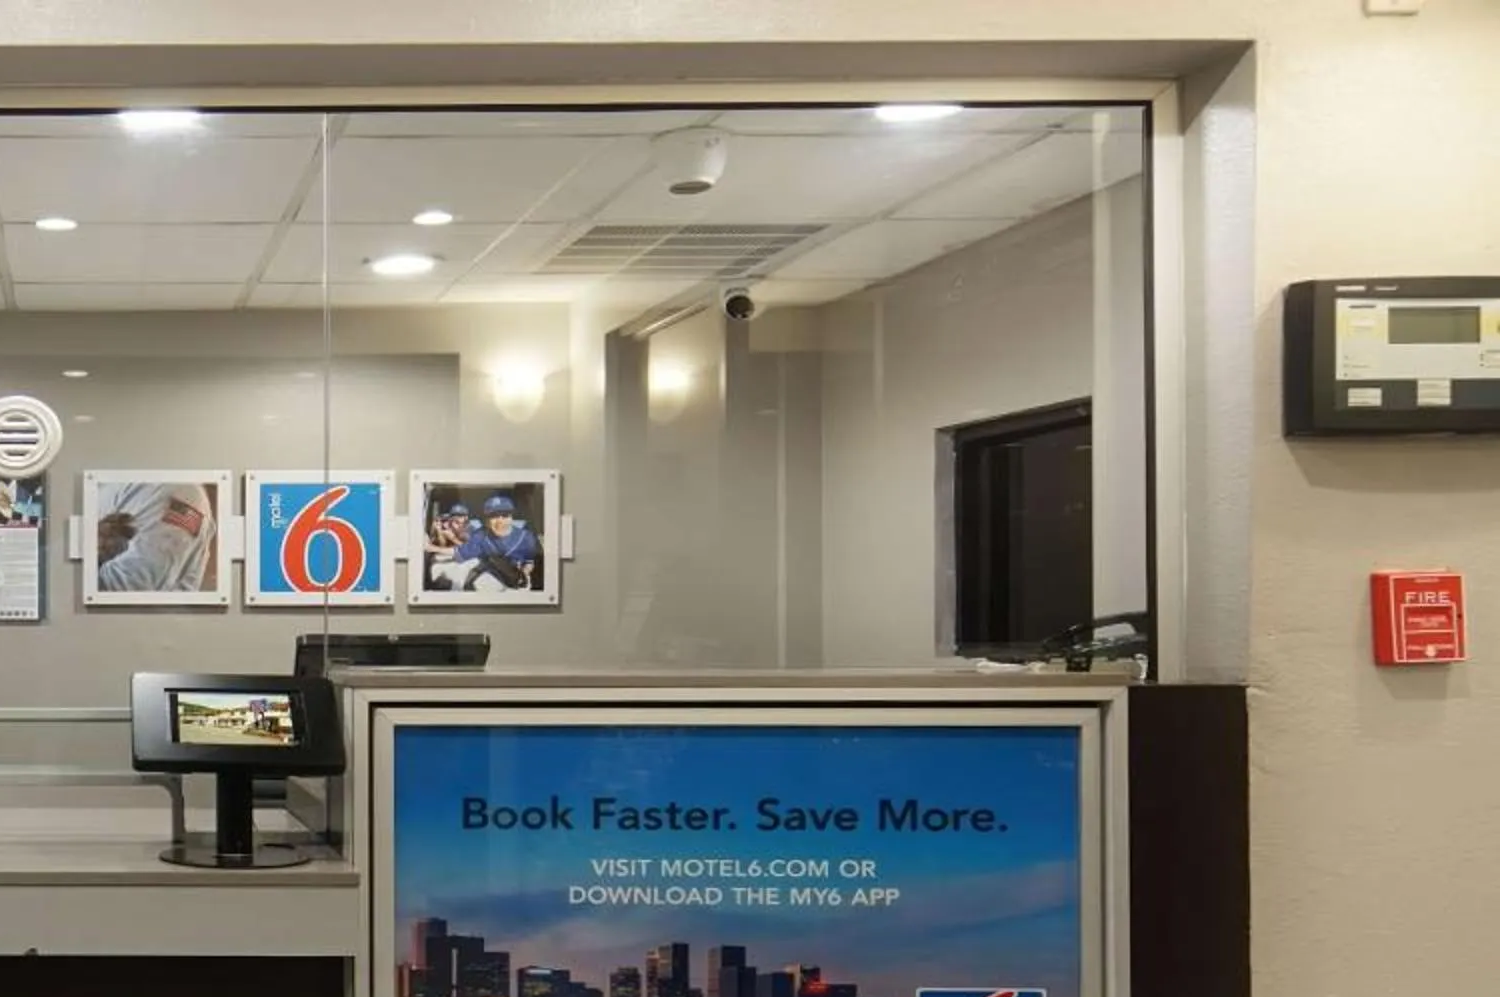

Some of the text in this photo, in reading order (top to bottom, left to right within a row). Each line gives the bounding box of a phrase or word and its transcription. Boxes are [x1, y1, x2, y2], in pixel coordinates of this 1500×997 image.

[280, 485, 366, 592] 6
[1404, 591, 1451, 604] FIRE
[462, 796, 1008, 833] Book Faster. Save More.
[590, 858, 877, 879] VISIT MOTEL6.COM OR
[568, 886, 901, 907] DOWNLOAD THE MY6 APP
